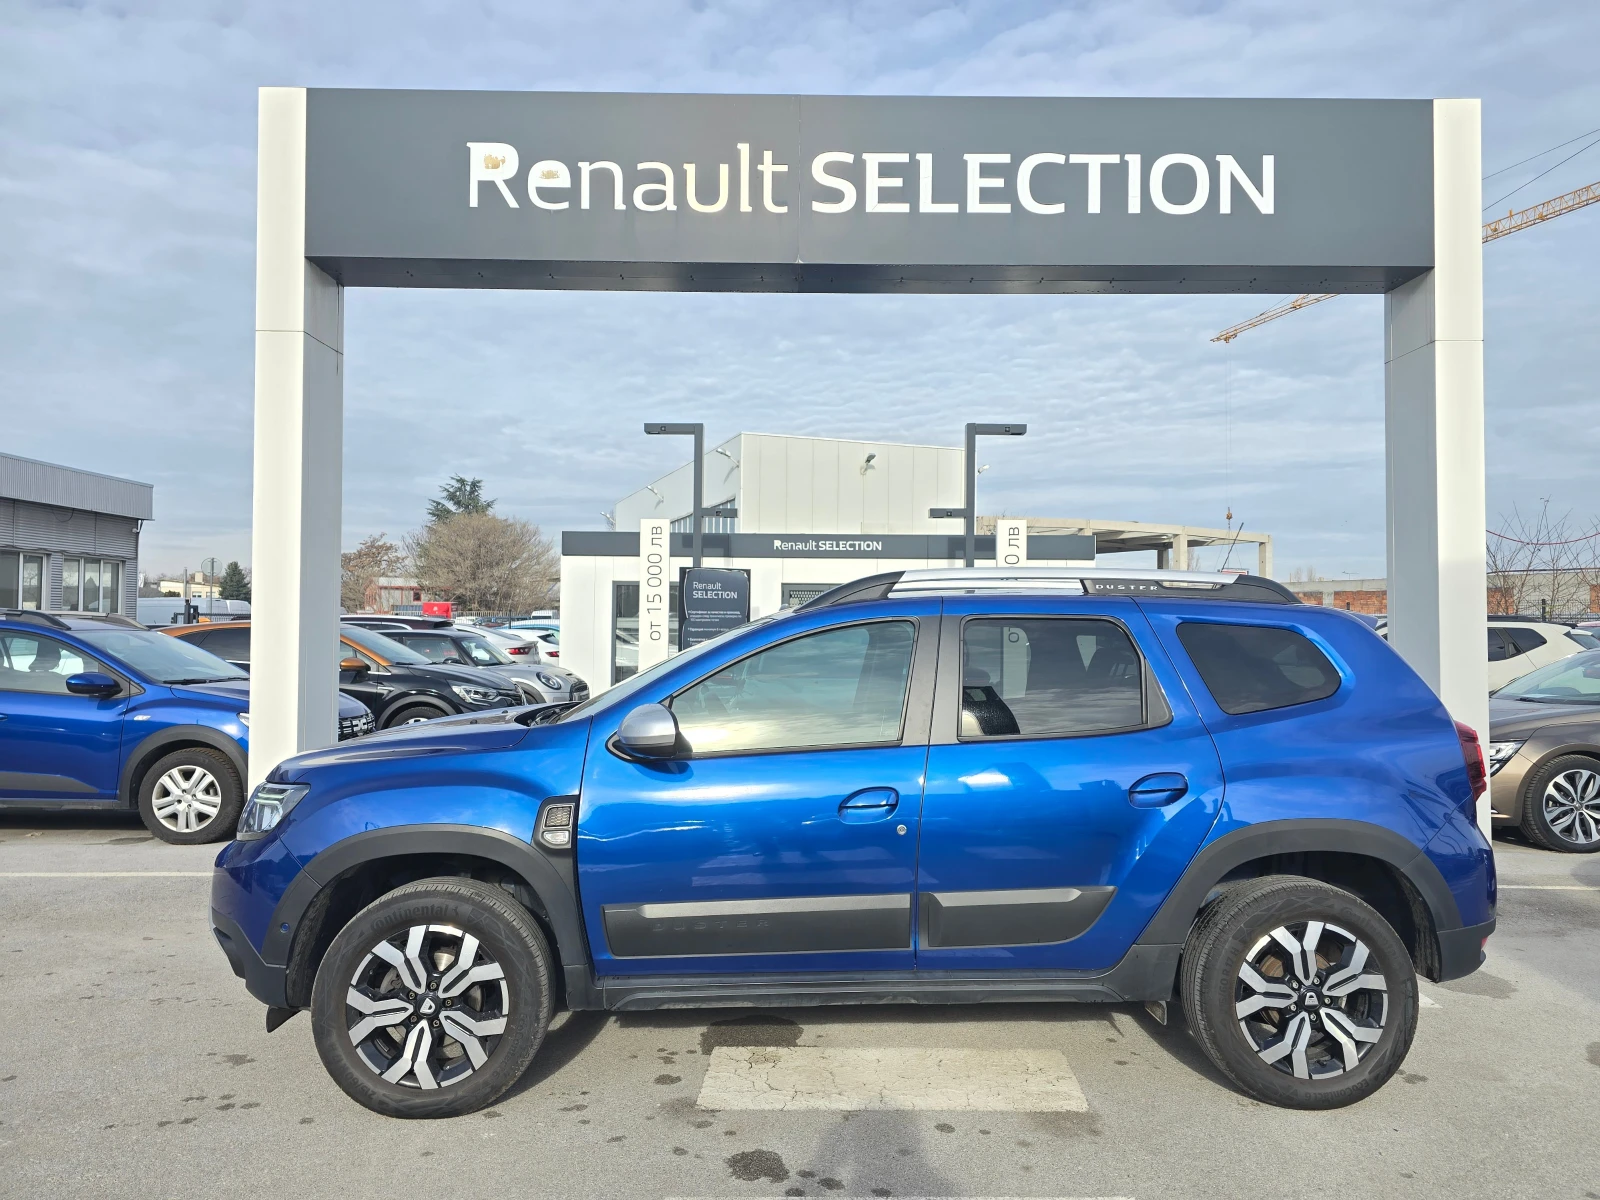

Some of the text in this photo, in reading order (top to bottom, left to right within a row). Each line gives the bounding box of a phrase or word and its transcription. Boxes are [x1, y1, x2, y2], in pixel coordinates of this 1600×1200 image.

[466, 142, 1275, 216] Renault SELECTION
[651, 526, 662, 548] лв
[773, 539, 882, 551] Renault SELECTION
[646, 553, 662, 588] 000
[692, 581, 722, 590] Renault
[692, 590, 738, 599] SELECTION
[646, 594, 662, 614] 15
[370, 903, 448, 932] Continental
[652, 919, 770, 932] DUSTER
